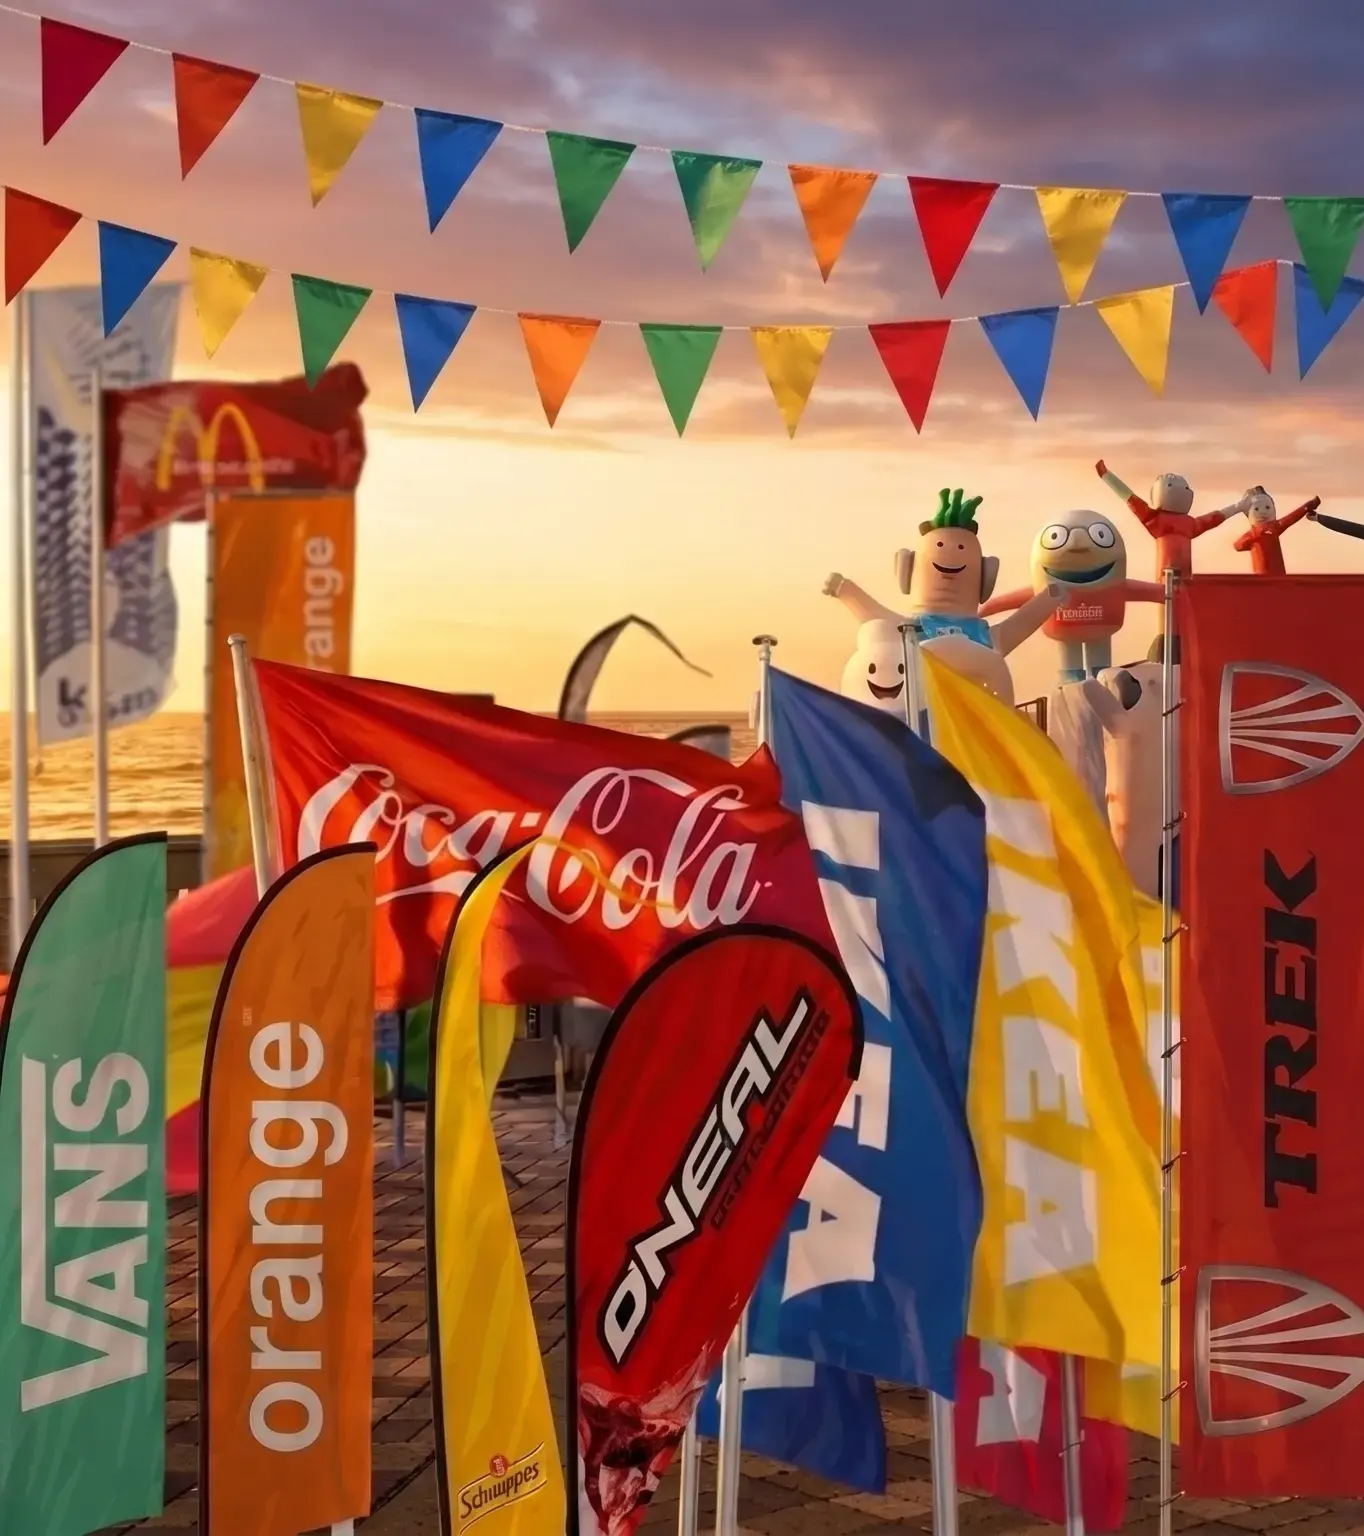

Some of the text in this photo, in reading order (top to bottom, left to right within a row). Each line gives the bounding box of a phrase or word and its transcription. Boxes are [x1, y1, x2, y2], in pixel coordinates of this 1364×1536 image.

[298, 763, 762, 930] Coca-Cola
[1264, 848, 1317, 1209] TREK
[21, 1052, 150, 1413] VANS
[249, 1021, 348, 1453] orange
